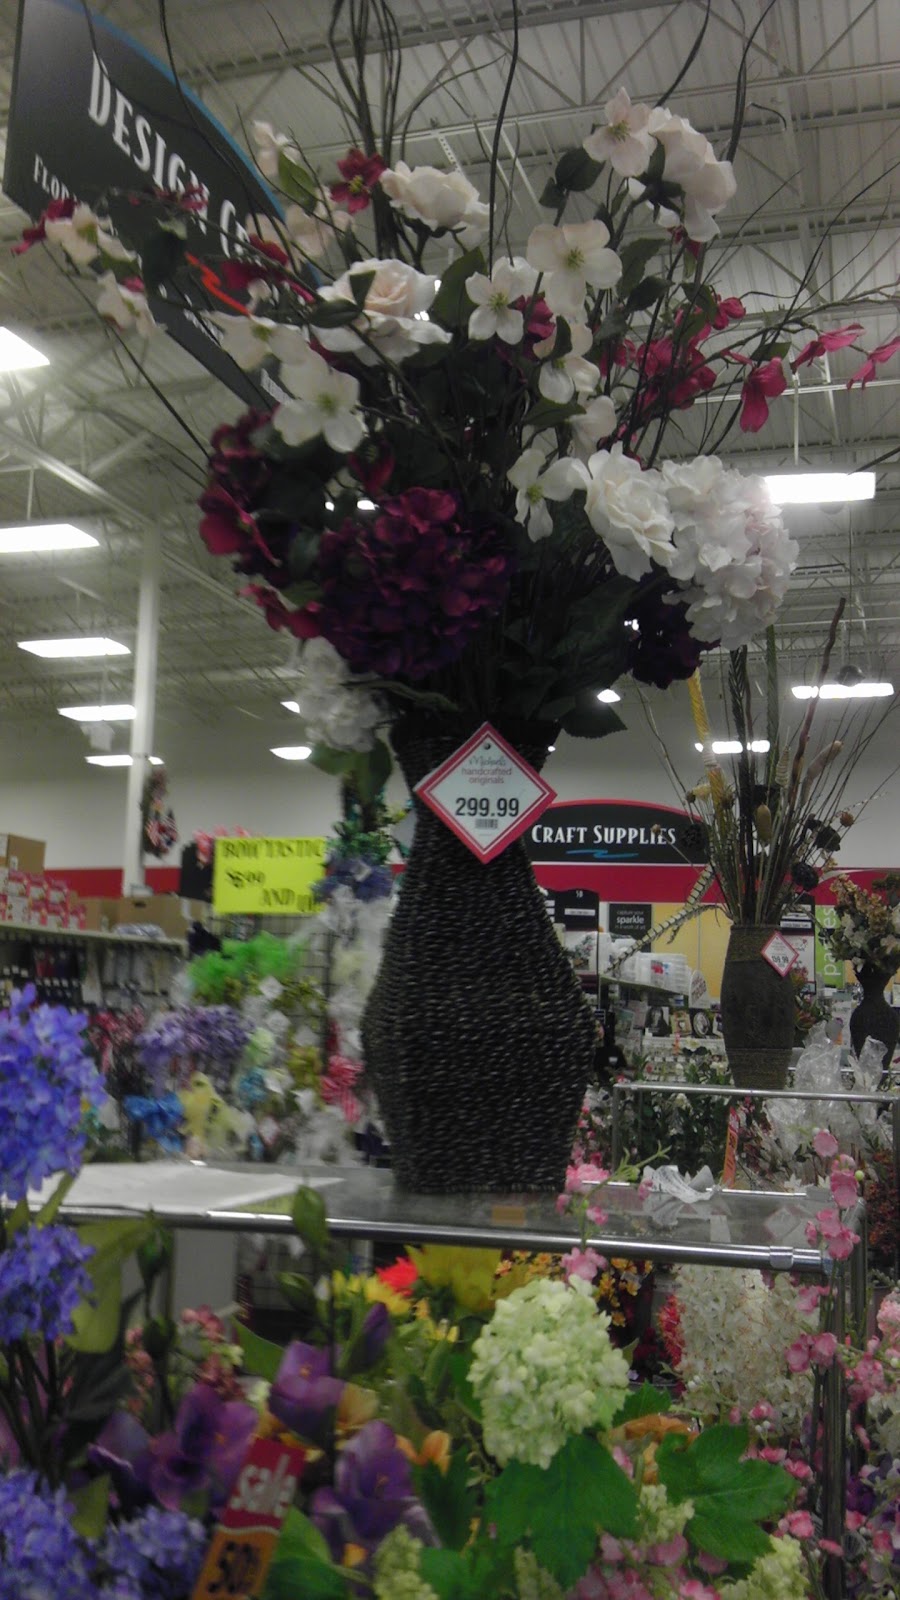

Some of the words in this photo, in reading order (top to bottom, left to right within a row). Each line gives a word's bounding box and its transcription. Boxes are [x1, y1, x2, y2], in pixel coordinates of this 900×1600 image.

[461, 767, 513, 776] handcrafted
[468, 776, 505, 786] originals
[455, 797, 519, 817] 299.99
[531, 824, 588, 844] CRAFT
[593, 825, 676, 845] SUPPLIES
[616, 915, 645, 925] sparkle
